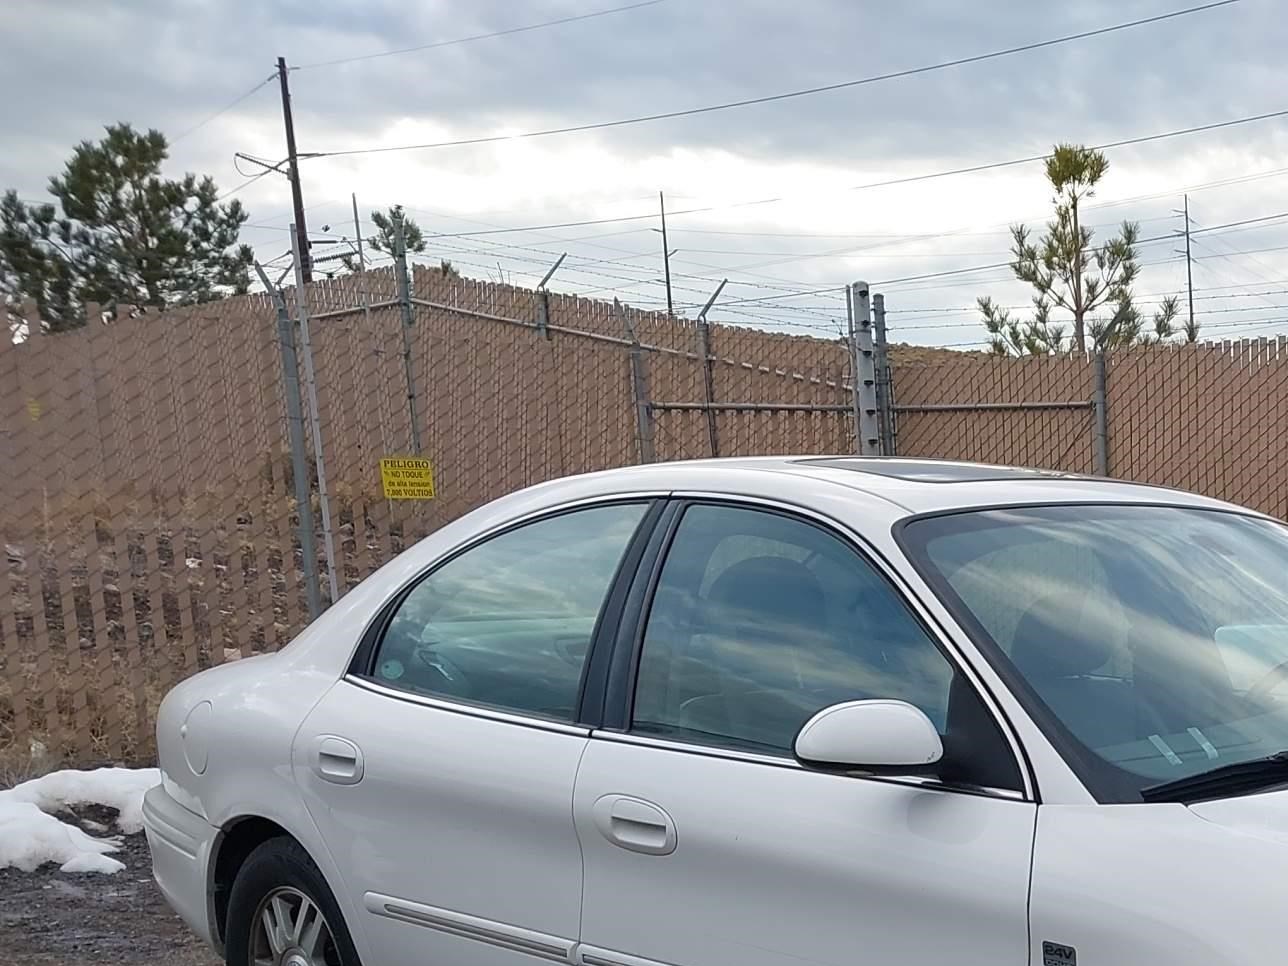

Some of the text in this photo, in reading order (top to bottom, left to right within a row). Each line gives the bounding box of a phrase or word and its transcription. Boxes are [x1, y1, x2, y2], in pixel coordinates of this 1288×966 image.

[384, 460, 429, 468] PELIGRO
[391, 470, 424, 478] NO TOQUE
[403, 488, 433, 496] VOLTIOS
